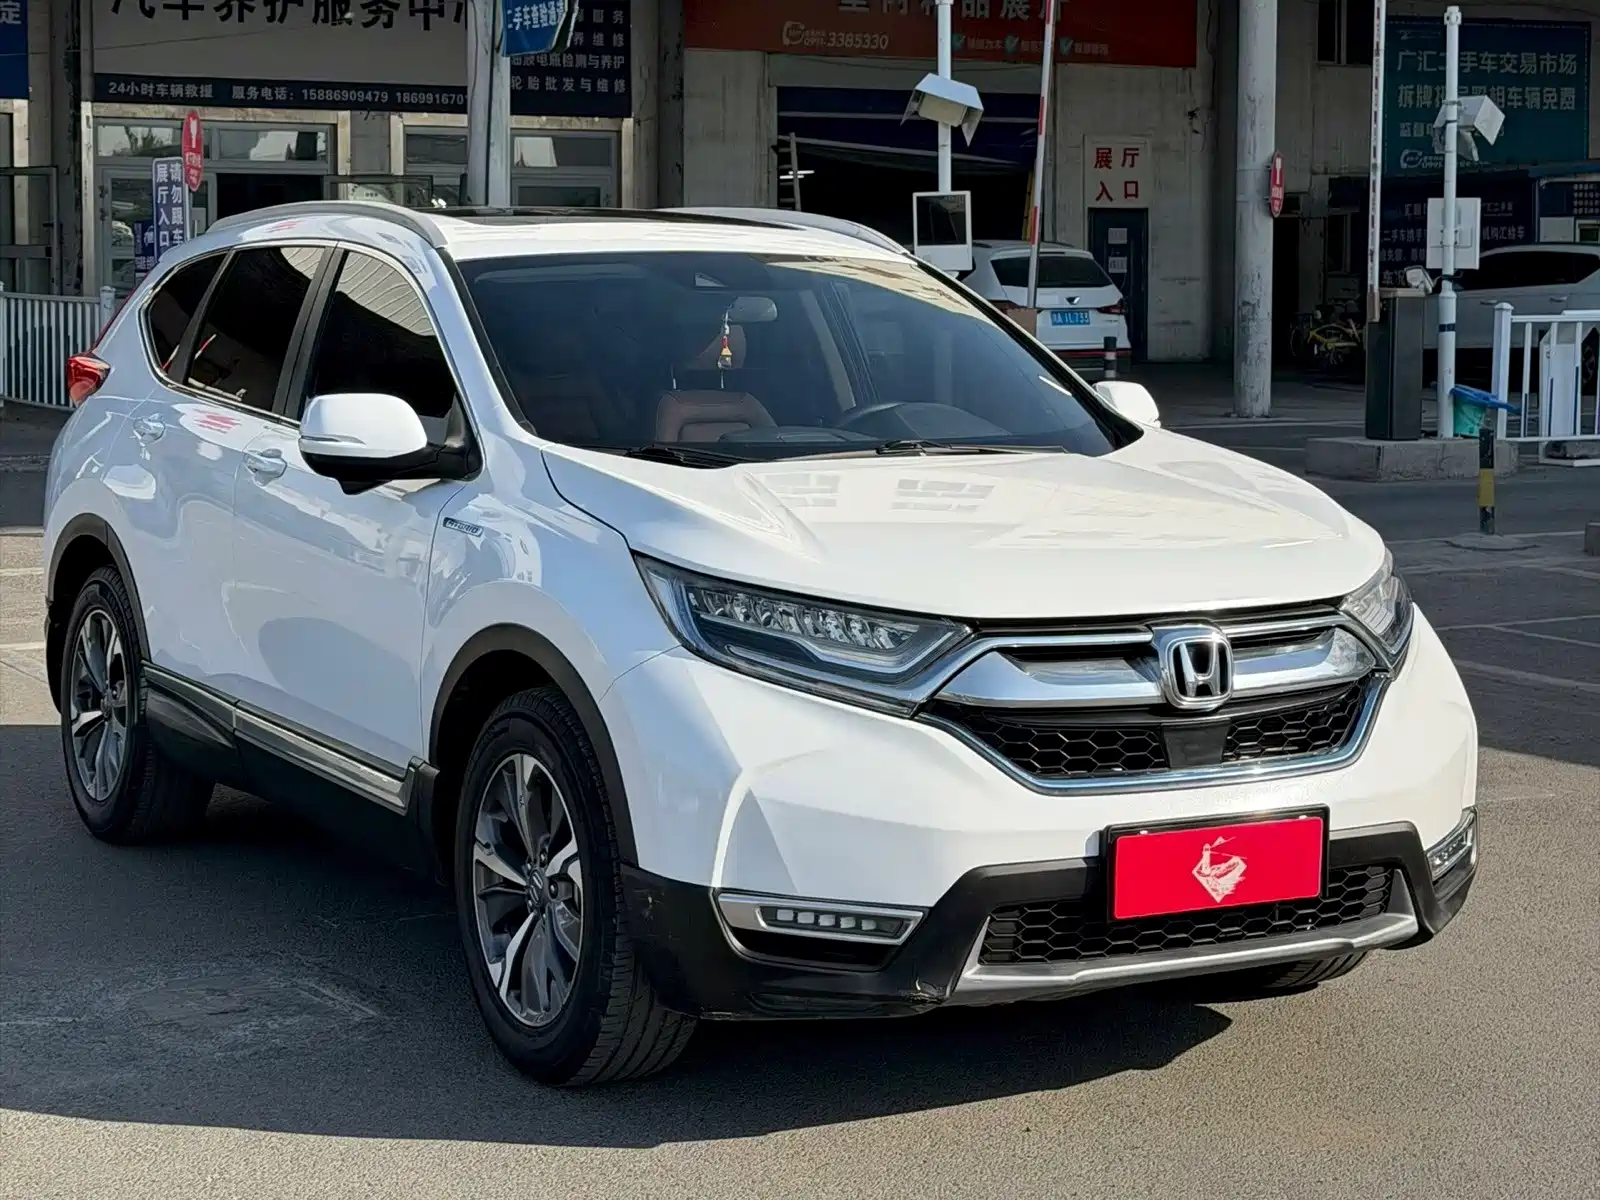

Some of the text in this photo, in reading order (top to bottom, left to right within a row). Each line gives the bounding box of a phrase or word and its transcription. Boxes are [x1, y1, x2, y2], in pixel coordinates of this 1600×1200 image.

[108, 81, 214, 99] 24小时车辆救援
[301, 88, 389, 104] 15886909479
[511, 76, 627, 93] 轮胎批发与维修
[1094, 148, 1140, 170] 展厅
[1095, 181, 1139, 202] 入口
[156, 164, 170, 248] 展厅入口
[170, 163, 184, 247] 请勿跟车
